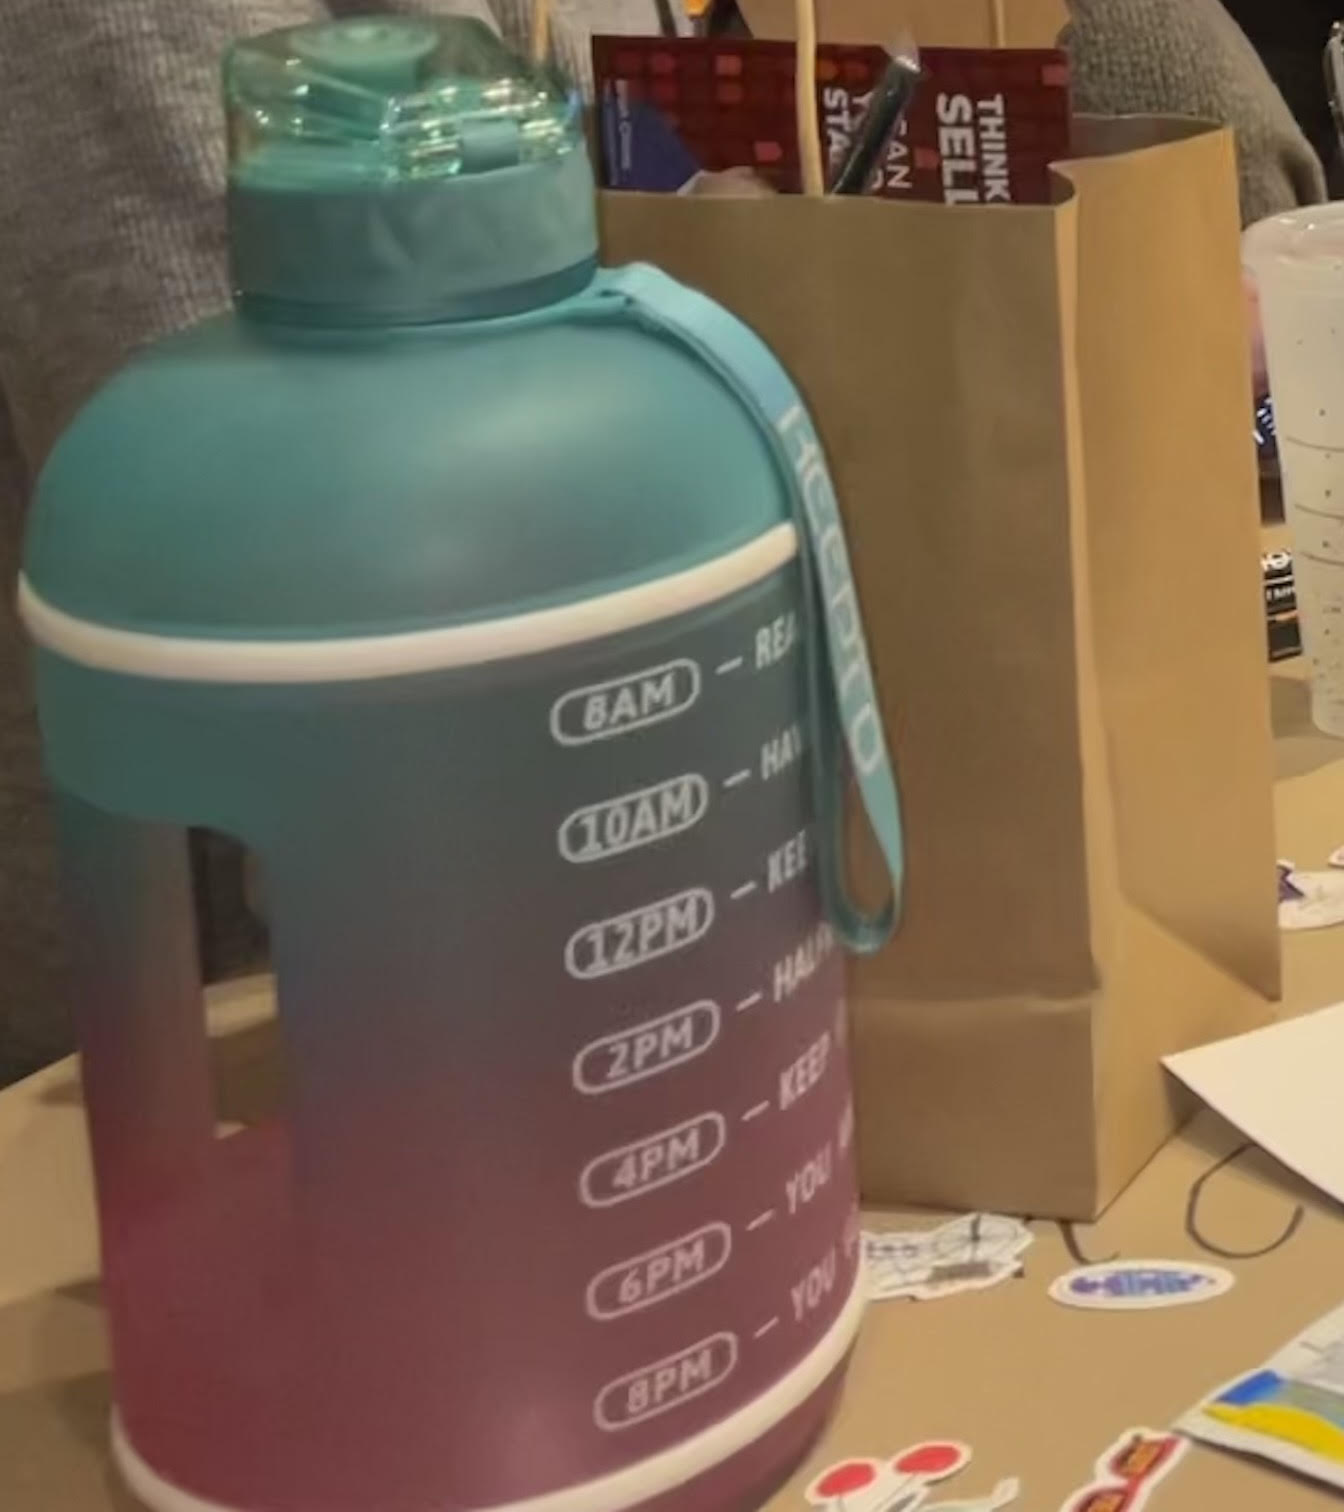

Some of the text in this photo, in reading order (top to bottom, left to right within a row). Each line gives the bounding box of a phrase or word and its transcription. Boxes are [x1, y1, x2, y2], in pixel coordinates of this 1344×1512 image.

[977, 93, 1011, 203] THINK
[583, 672, 676, 731] 8AM
[578, 779, 694, 858] 10AM
[584, 895, 699, 974] 12PM
[607, 1016, 693, 1079] 2PM
[612, 1128, 700, 1188] 4PM
[618, 1142, 832, 1304] 6PM YOU
[627, 1247, 837, 1414] 8PM YOU
